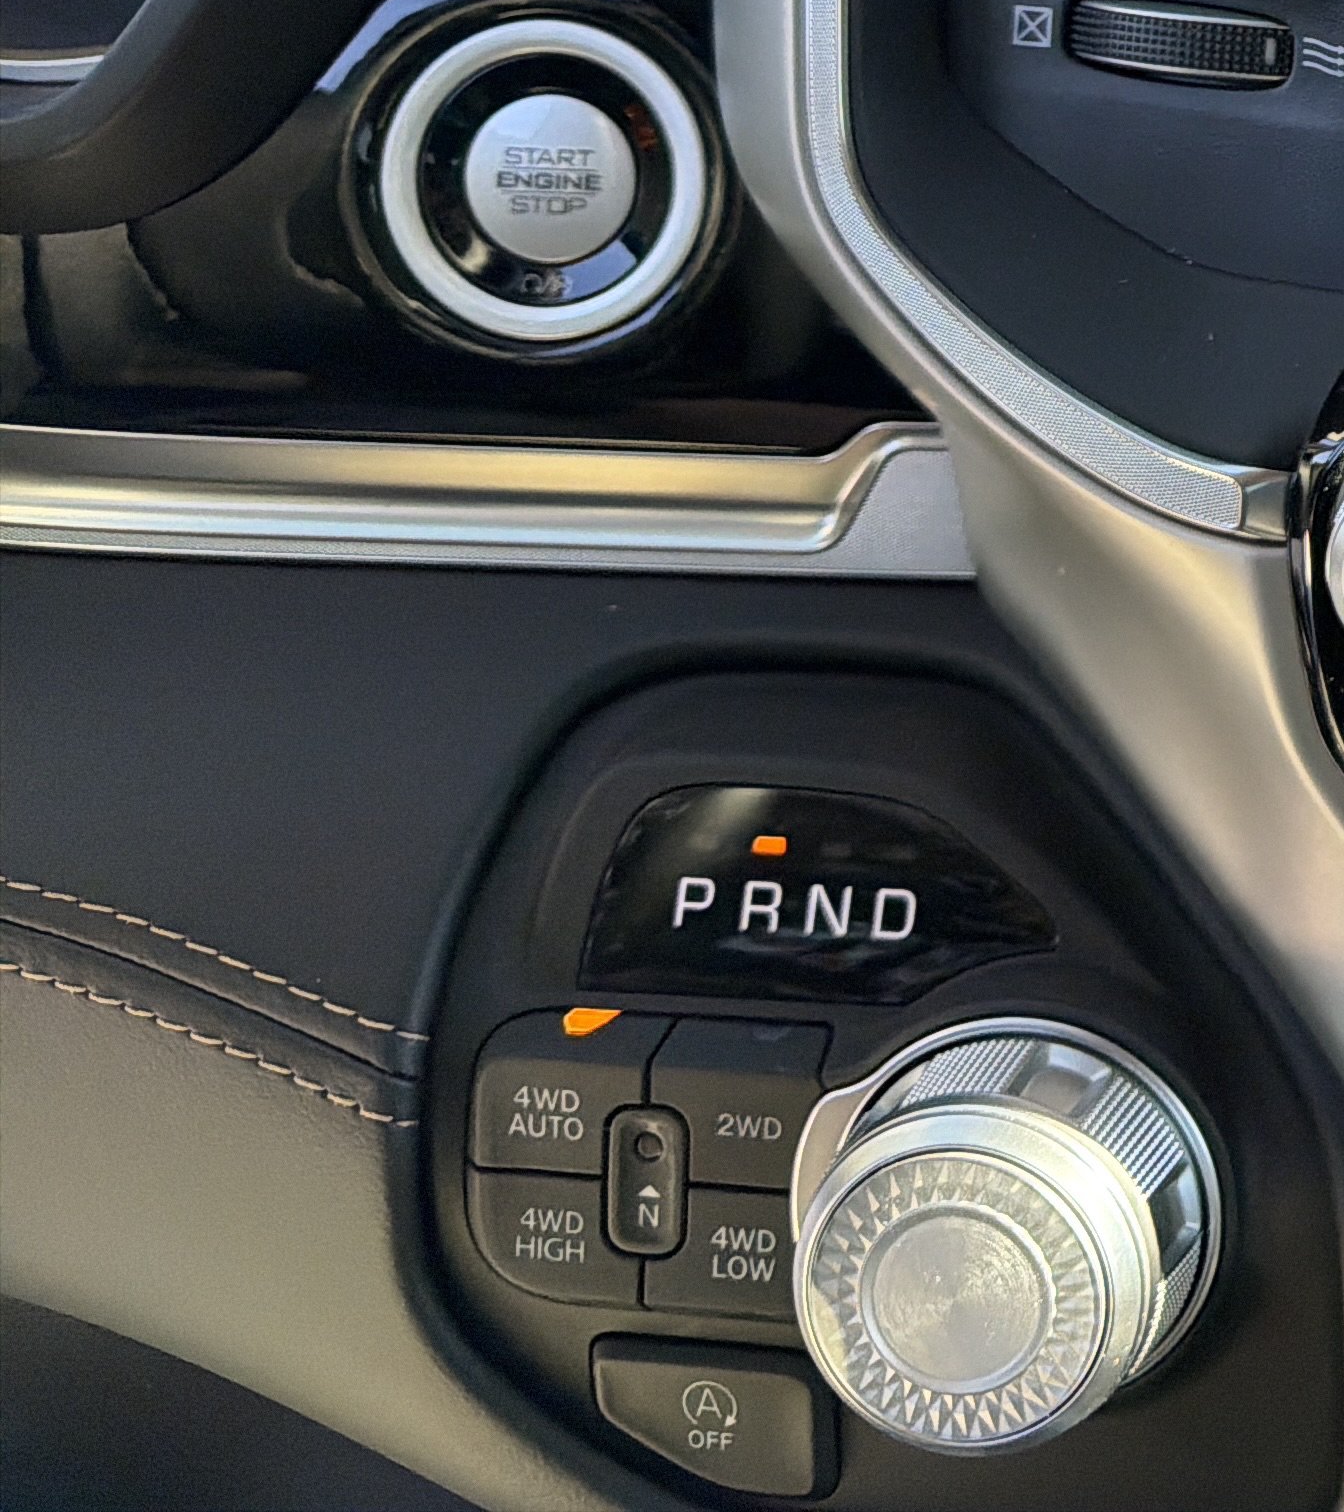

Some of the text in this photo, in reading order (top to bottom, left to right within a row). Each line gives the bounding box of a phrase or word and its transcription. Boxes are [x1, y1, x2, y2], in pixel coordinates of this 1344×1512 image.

[504, 147, 595, 168] START
[496, 170, 603, 192] ENGINE
[510, 195, 590, 216] STOP
[512, 1086, 581, 1113] 4WD
[507, 1115, 585, 1142] AUTO
[715, 1113, 784, 1141] 2WD
[519, 1210, 586, 1236] 4WD
[515, 1237, 586, 1265] HIGH
[710, 1226, 777, 1255] 4WD
[711, 1254, 775, 1282] LOW
[687, 1429, 734, 1451] OFF
